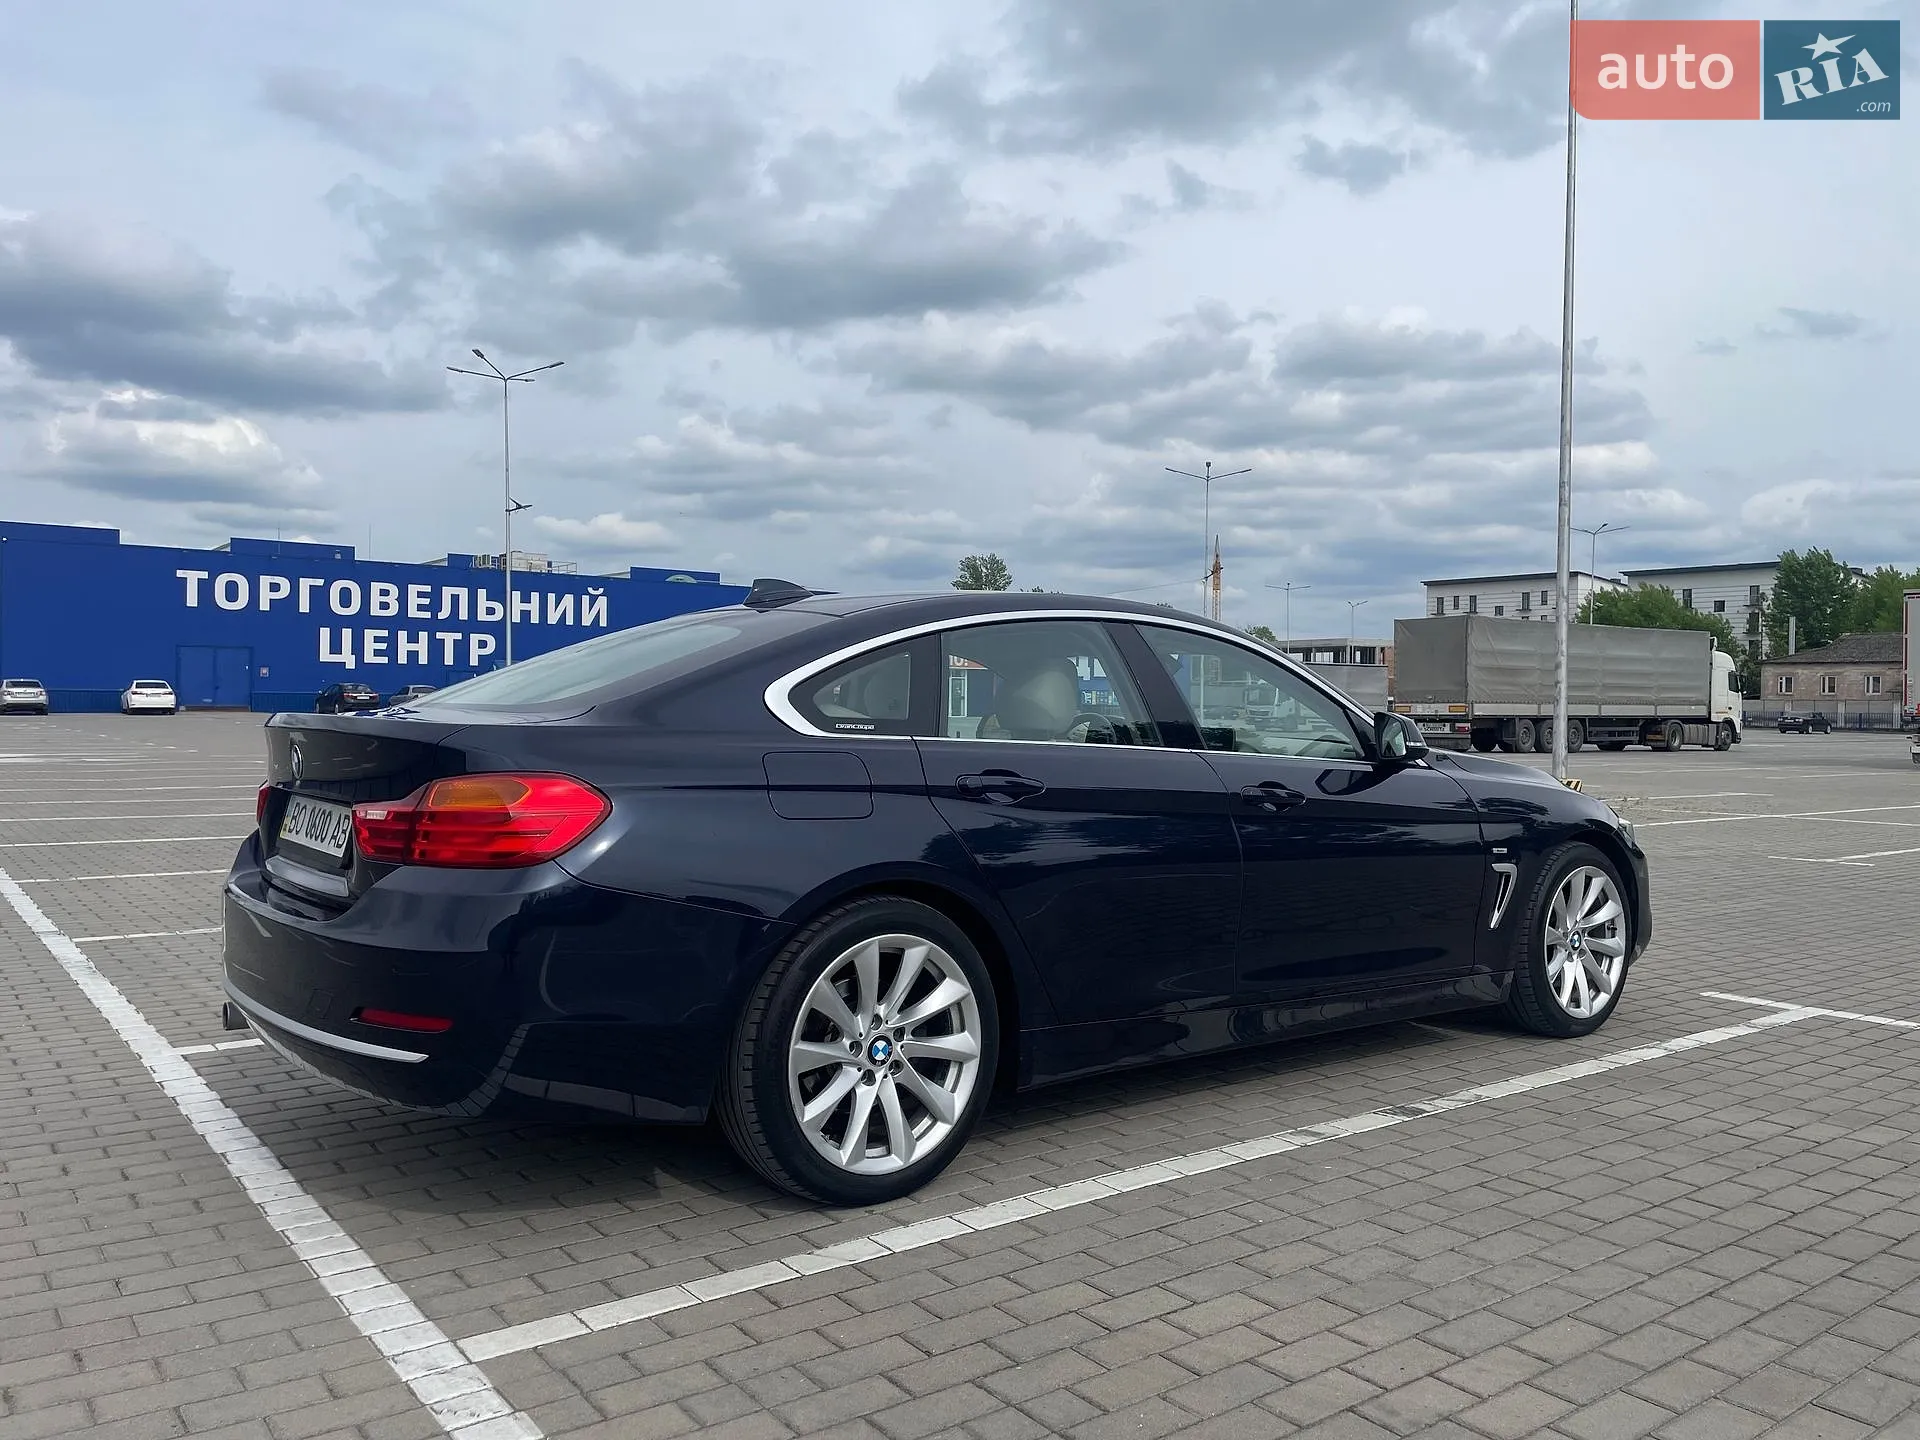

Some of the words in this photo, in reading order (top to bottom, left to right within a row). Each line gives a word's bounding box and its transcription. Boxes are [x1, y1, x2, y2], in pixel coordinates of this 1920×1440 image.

[176, 569, 608, 627] ТОРГОВЕЛЬНИЙ
[319, 627, 496, 669] ЦЕНТР
[288, 802, 307, 836] BO
[305, 806, 333, 843] 0600
[328, 814, 351, 849] AB
